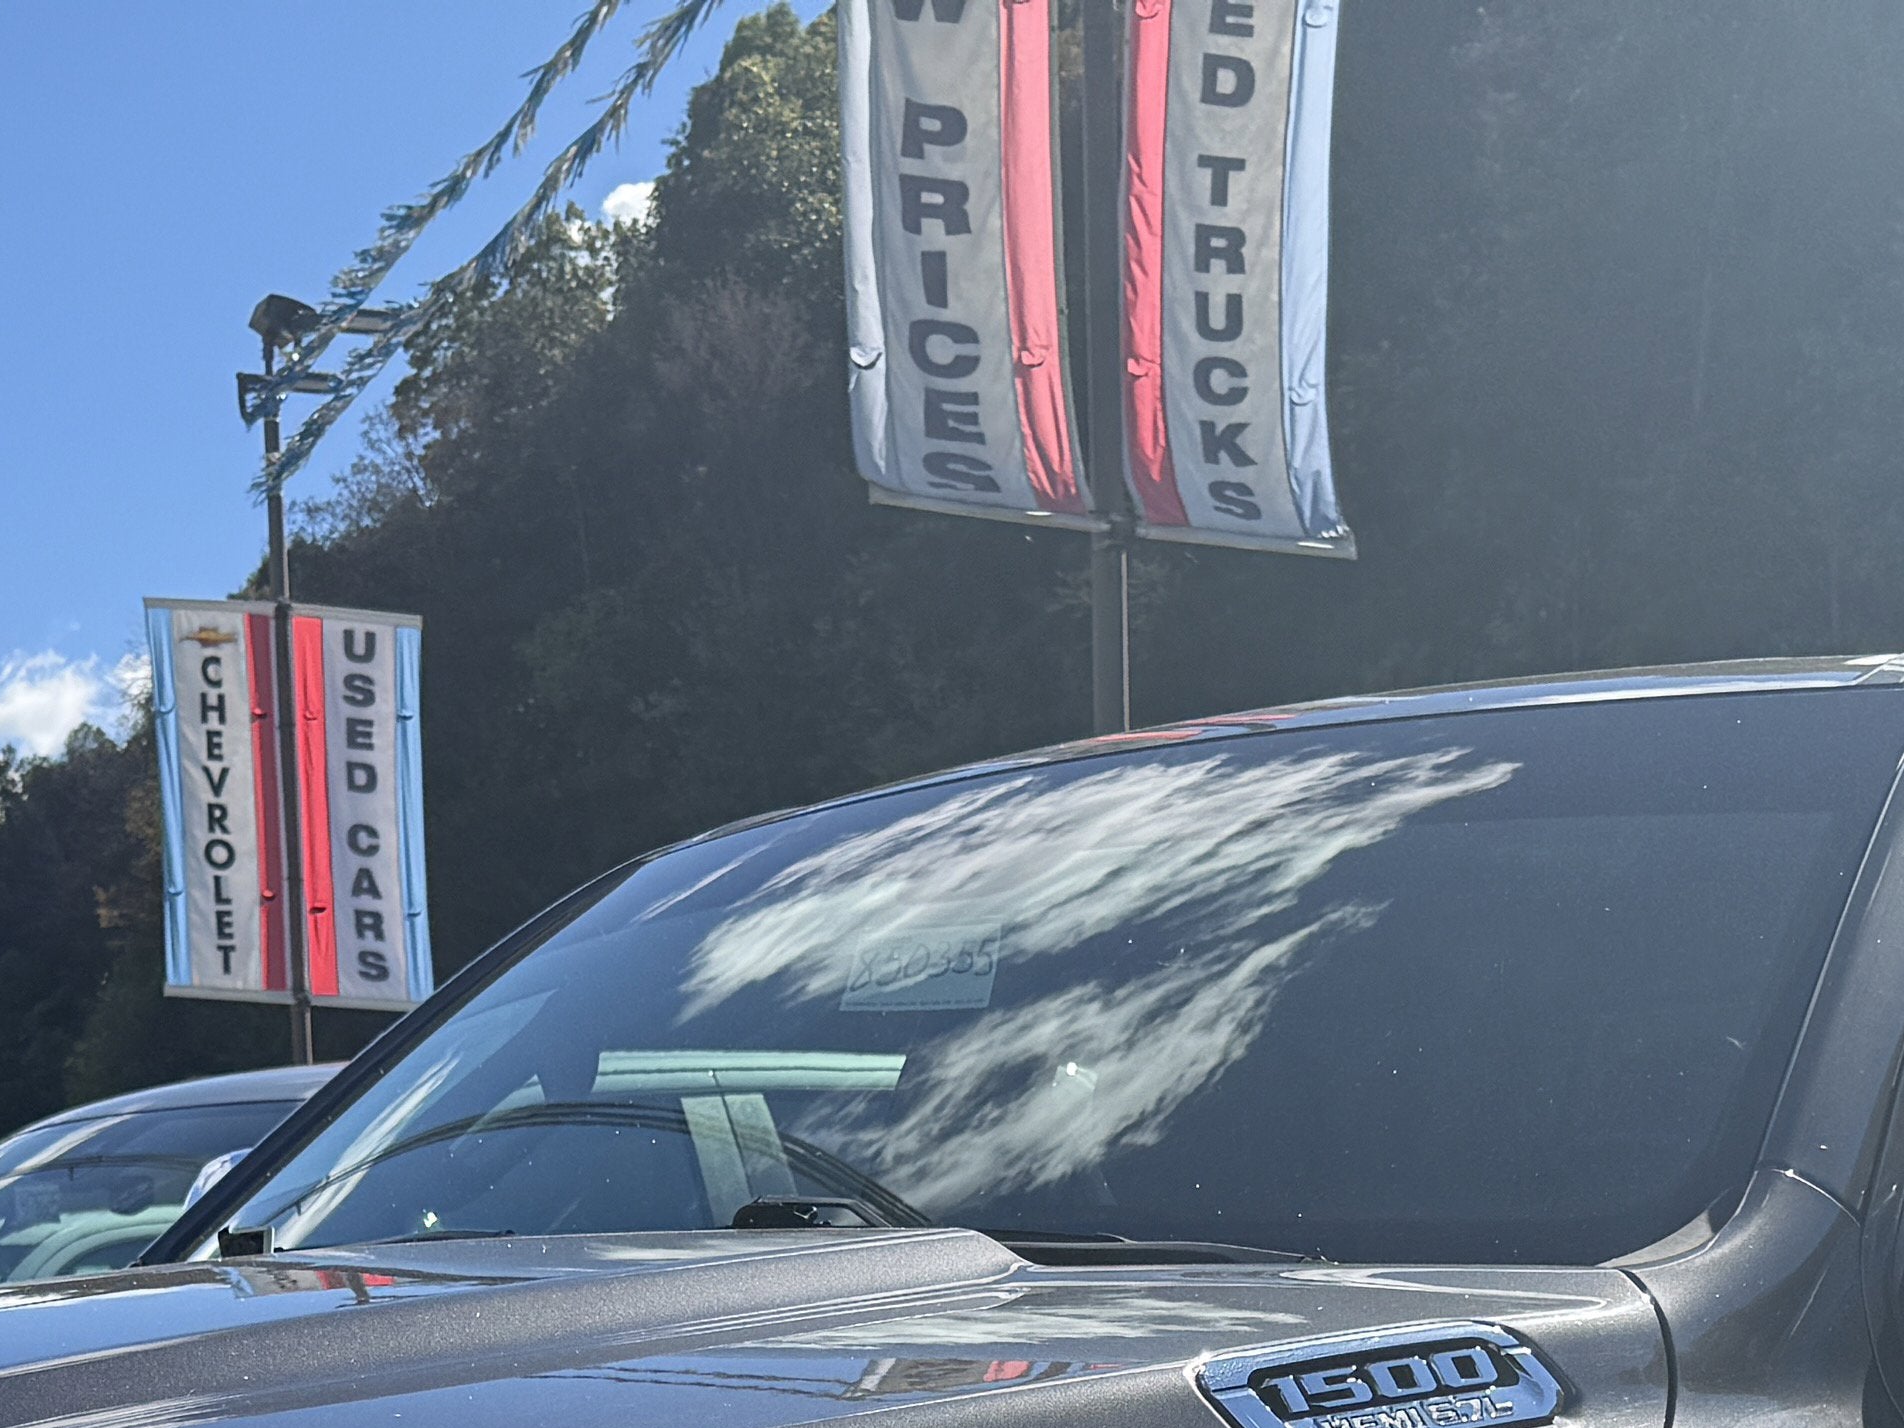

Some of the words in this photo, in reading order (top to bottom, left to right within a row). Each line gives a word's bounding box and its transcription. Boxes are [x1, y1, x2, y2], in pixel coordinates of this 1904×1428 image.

[898, 97, 1002, 494] PRICES
[1193, 154, 1263, 521] TRUCKS
[200, 656, 237, 976] CHEVROLET
[343, 629, 378, 795] USED
[346, 824, 390, 983] CARS
[1263, 1345, 1499, 1414] 1500
